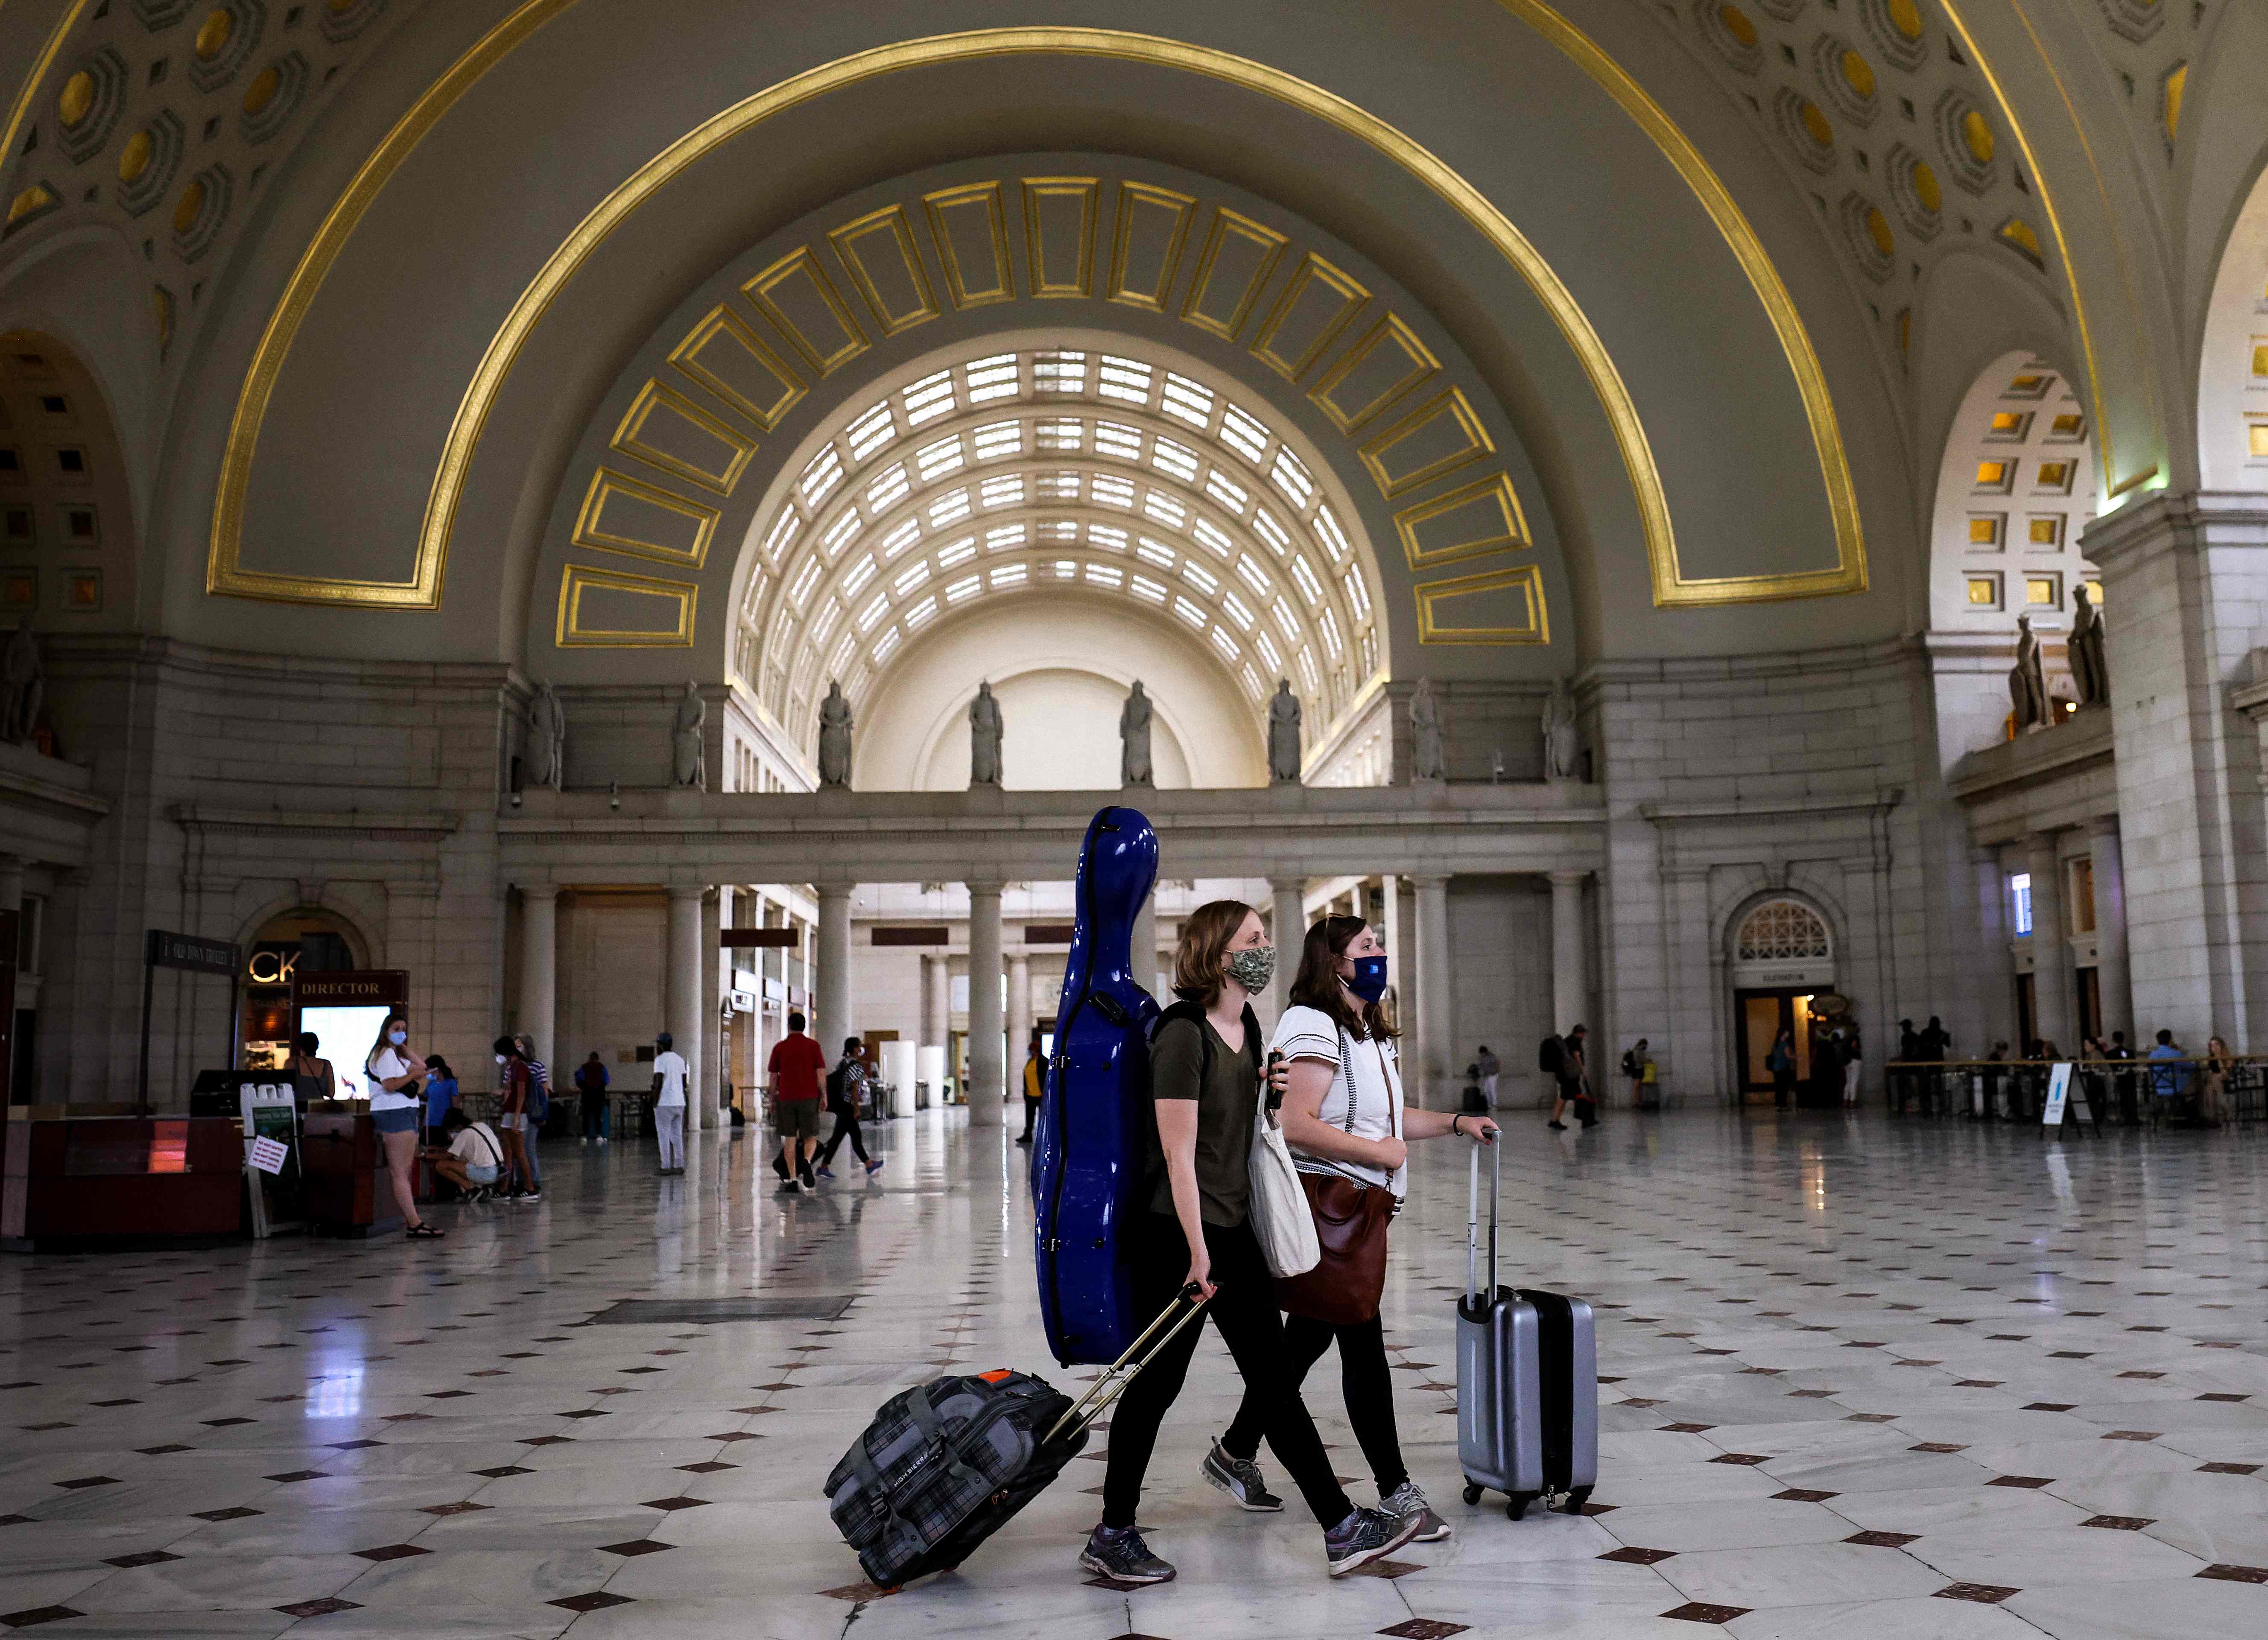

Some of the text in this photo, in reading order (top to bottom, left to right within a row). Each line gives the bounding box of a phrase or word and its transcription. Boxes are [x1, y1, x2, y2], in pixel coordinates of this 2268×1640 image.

[301, 982, 380, 994] DIRECTOR
[893, 1452, 929, 1487] HIGH SIERRA
